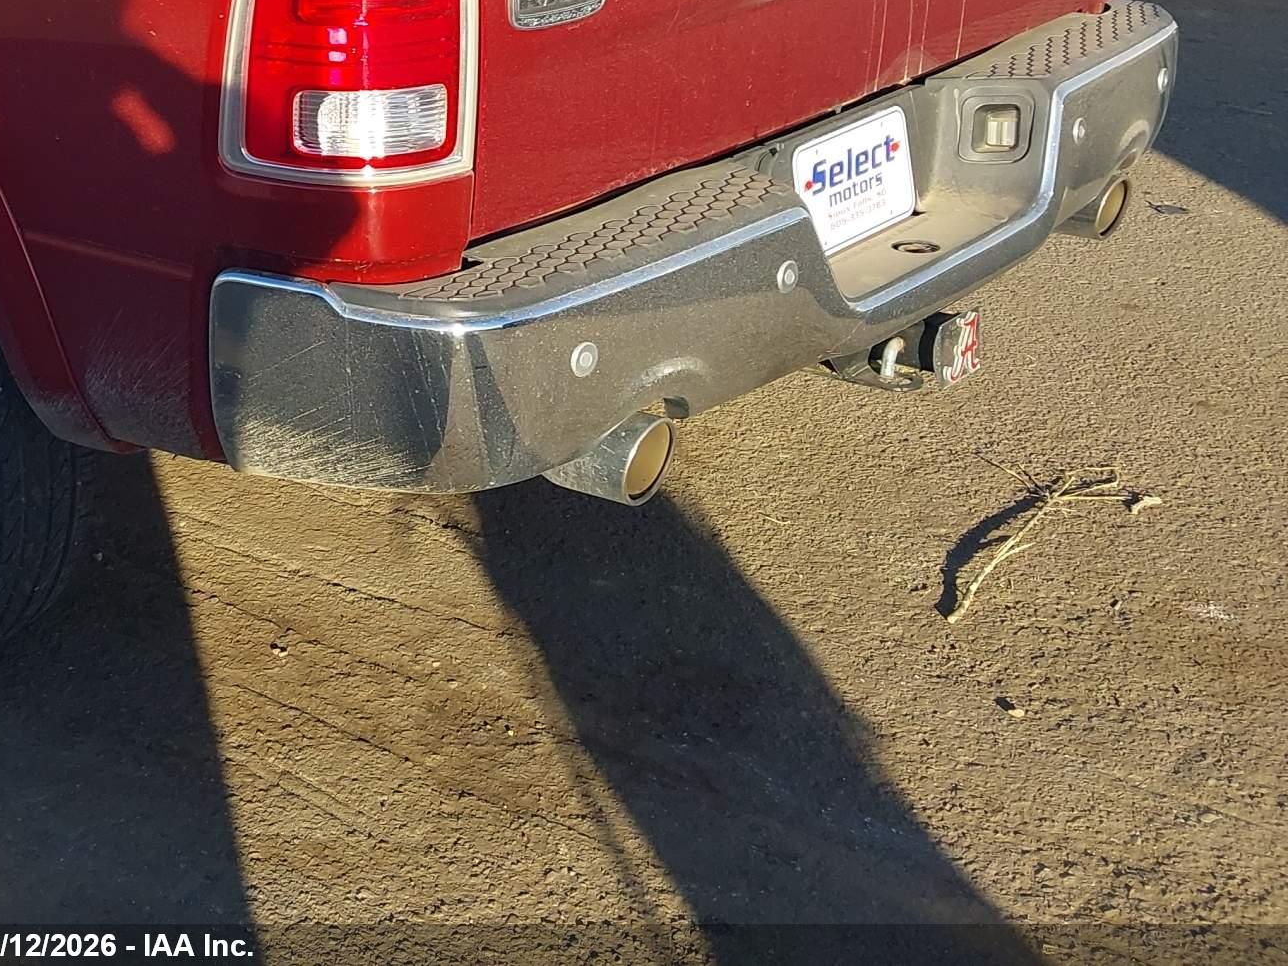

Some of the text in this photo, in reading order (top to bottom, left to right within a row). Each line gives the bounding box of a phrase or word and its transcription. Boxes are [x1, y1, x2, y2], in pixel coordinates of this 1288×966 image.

[812, 133, 896, 197] Select
[829, 171, 883, 208] motors
[943, 311, 981, 384] A
